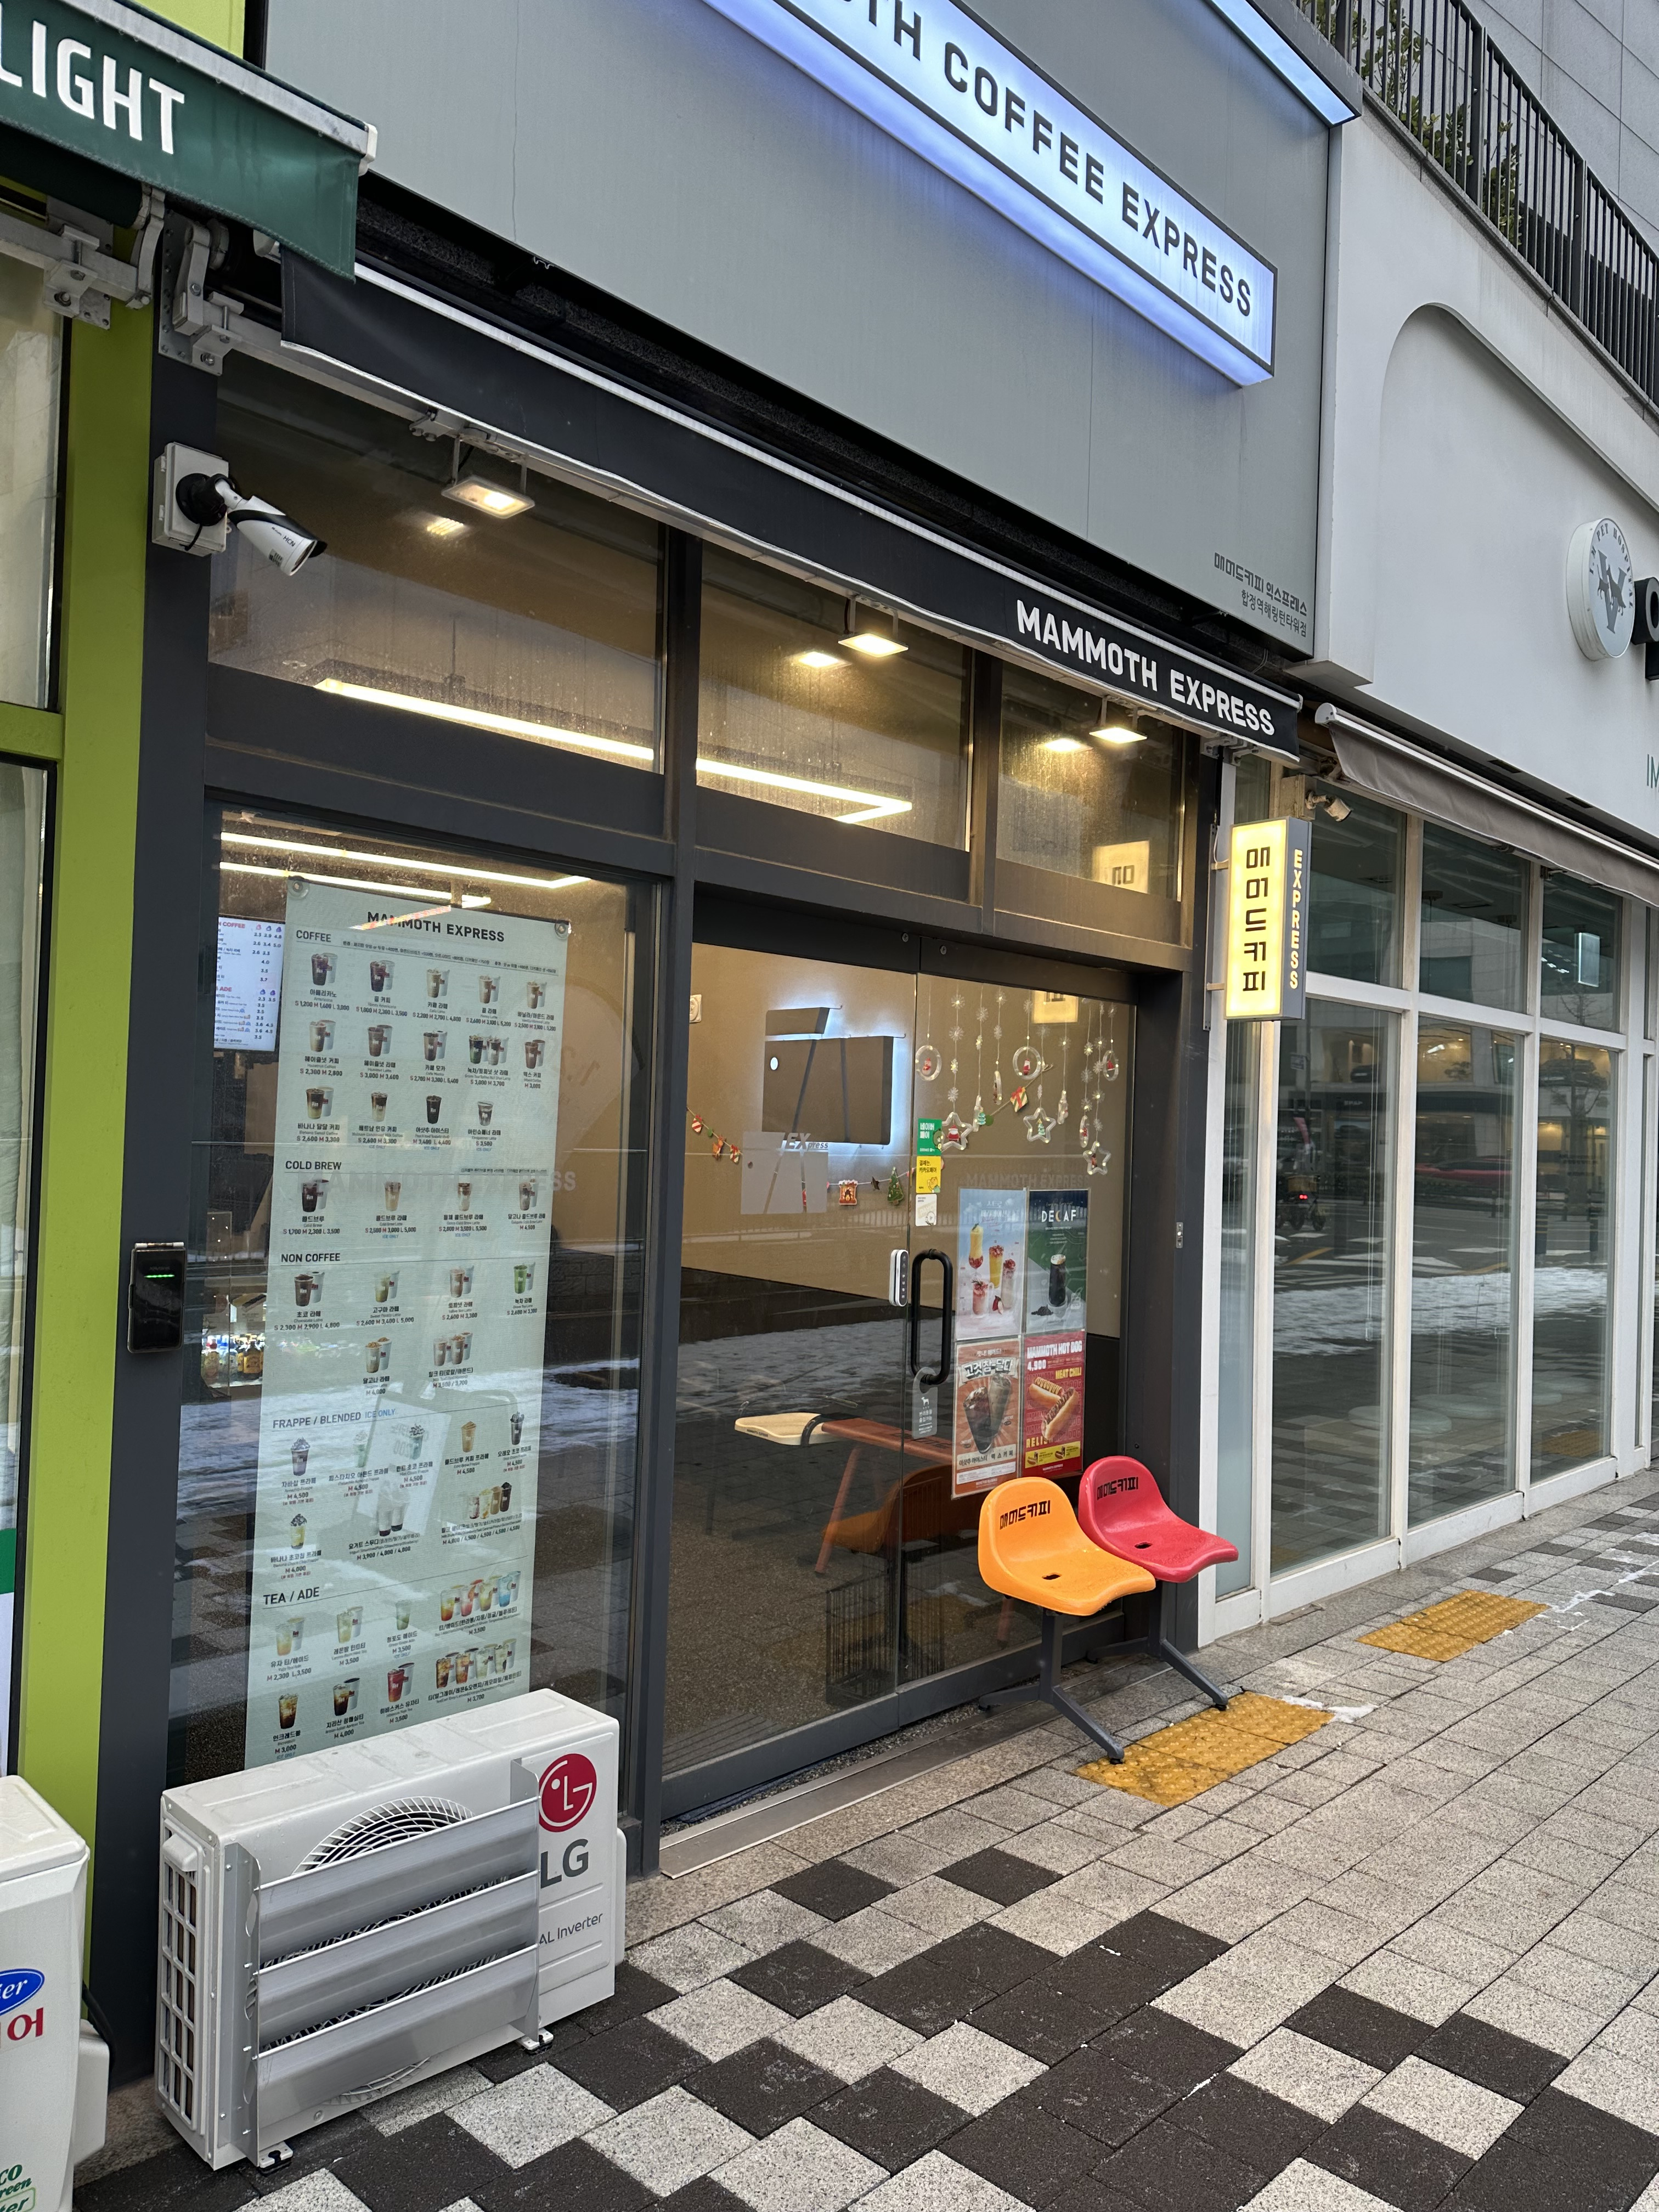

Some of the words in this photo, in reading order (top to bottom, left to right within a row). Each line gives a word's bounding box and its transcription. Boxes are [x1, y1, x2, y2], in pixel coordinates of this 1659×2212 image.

[944, 41, 1104, 205] COFFEE
[1121, 180, 1251, 317] EXPRESS
[1596, 523, 1609, 542] PET
[1214, 552, 1264, 593] 매머드커피
[1266, 582, 1307, 617] 익스프레스
[1241, 589, 1307, 637] 합정역해링턴타워점
[1017, 599, 1158, 692] MAMMOTH
[1170, 668, 1275, 736] EXPRESS
[1243, 846, 1271, 992] 매머드커피
[1290, 849, 1303, 989] EXPRESS
[296, 930, 332, 943] COFFEE
[447, 923, 505, 942] EXPRESS
[309, 989, 337, 998] 아메리카노
[920, 1122, 935, 1131] 네이버
[285, 1160, 312, 1170] COLD
[315, 1161, 342, 1170] BREW
[1041, 1209, 1077, 1222] DECAF
[281, 1254, 302, 1262] NON
[306, 1253, 341, 1262] COFFEE
[1027, 1344, 1058, 1359] MAMMOTH
[1058, 1342, 1070, 1355] HOT
[1070, 1340, 1082, 1353] DOG
[1027, 1359, 1047, 1372] 4,900
[273, 1417, 311, 1429] FRAPPE
[320, 1412, 361, 1424] BLENDED
[365, 1410, 376, 1419] ICE
[378, 1408, 396, 1417] ONLY
[1097, 1476, 1139, 1501] 매머드커피
[1000, 1499, 1051, 1530] 매머드커피
[263, 1594, 286, 1605] TEA
[297, 1587, 320, 1600] ADE
[540, 1838, 589, 1889] LG
[557, 1912, 603, 1940] Inverter
[0, 1979, 28, 2000] er
[0, 2007, 44, 2041] 어
